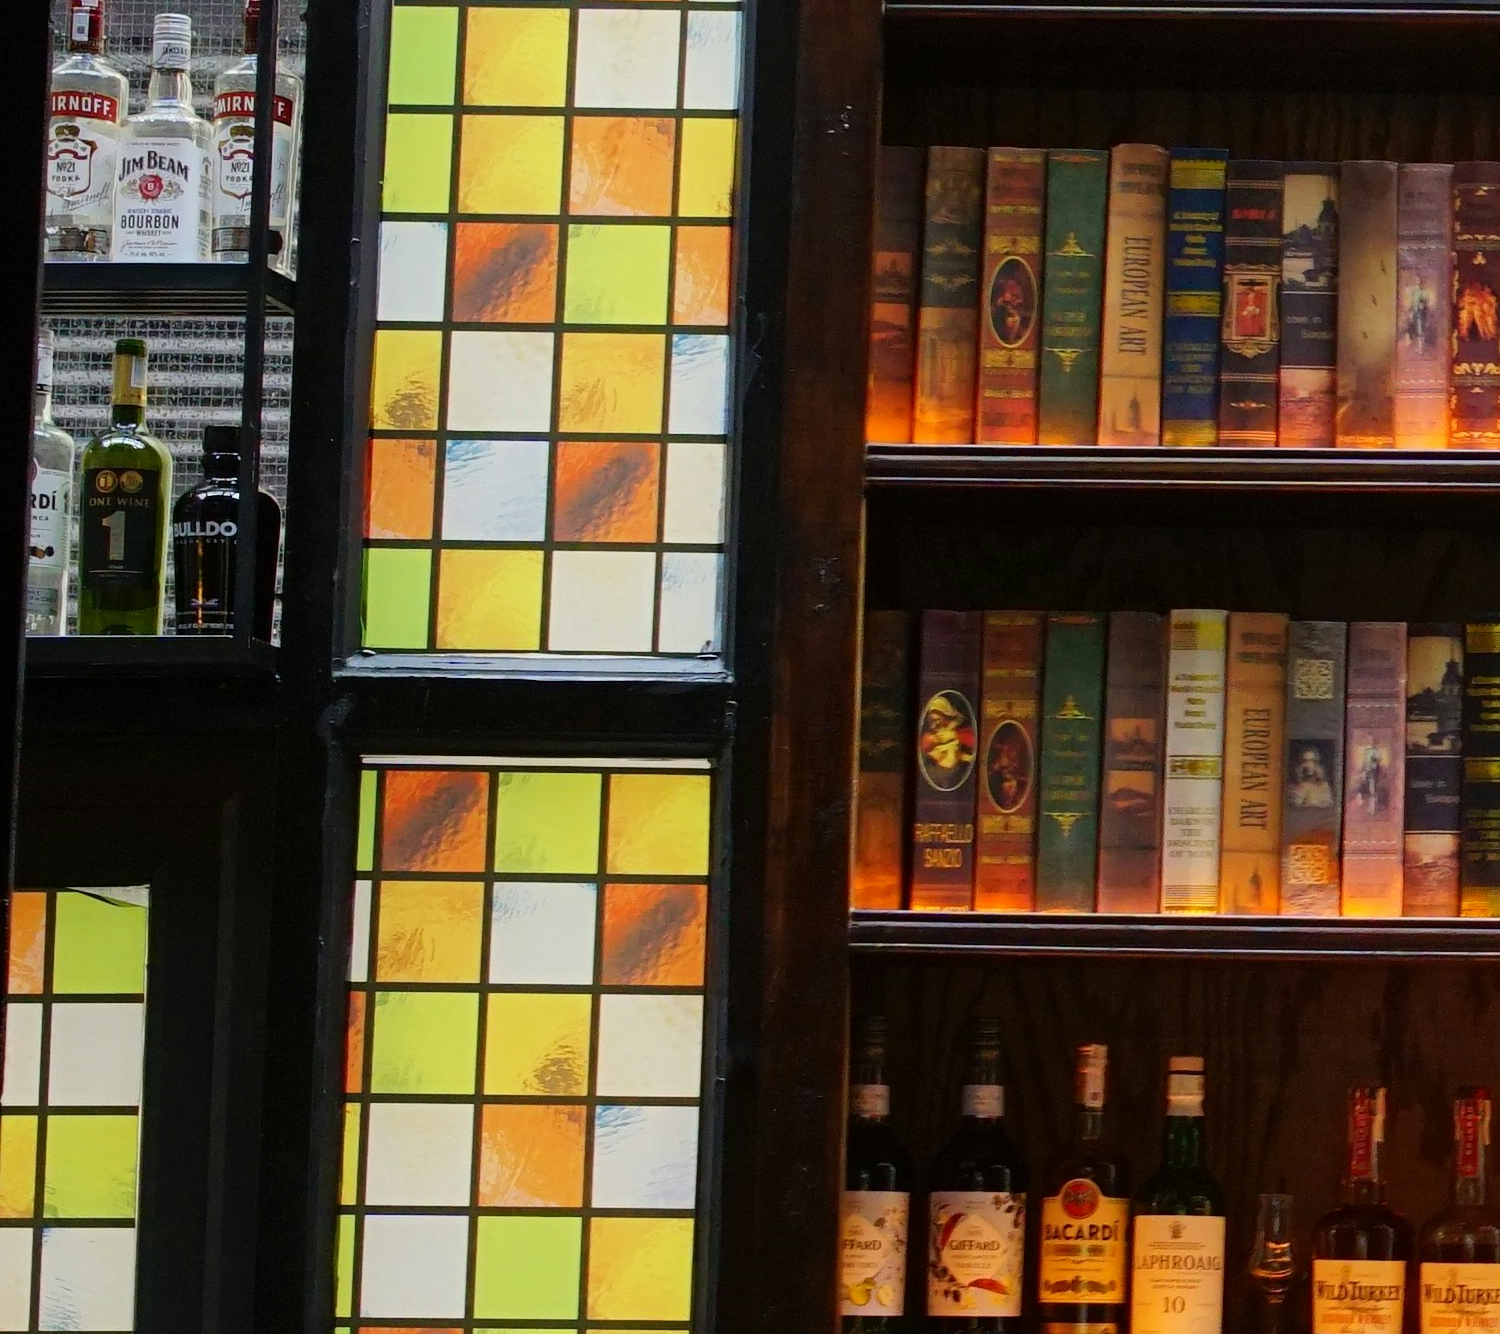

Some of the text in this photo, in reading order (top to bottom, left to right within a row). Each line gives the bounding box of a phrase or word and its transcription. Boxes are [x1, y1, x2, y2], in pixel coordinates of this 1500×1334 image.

[52, 95, 112, 116] IRNOFF
[214, 94, 287, 118] SMIRNF
[119, 151, 190, 183] JIM BEAM
[121, 214, 180, 230] BOURBON
[1118, 236, 1151, 356] EUROPEAN ART
[89, 497, 150, 508] ONE WINE
[102, 511, 125, 560] 1
[174, 521, 237, 537] BULLDO
[1239, 708, 1271, 830] EUROPEAN ART
[842, 1240, 882, 1251] FFARD
[950, 1240, 1001, 1251] GIFFARD
[1162, 1297, 1187, 1314] 10
